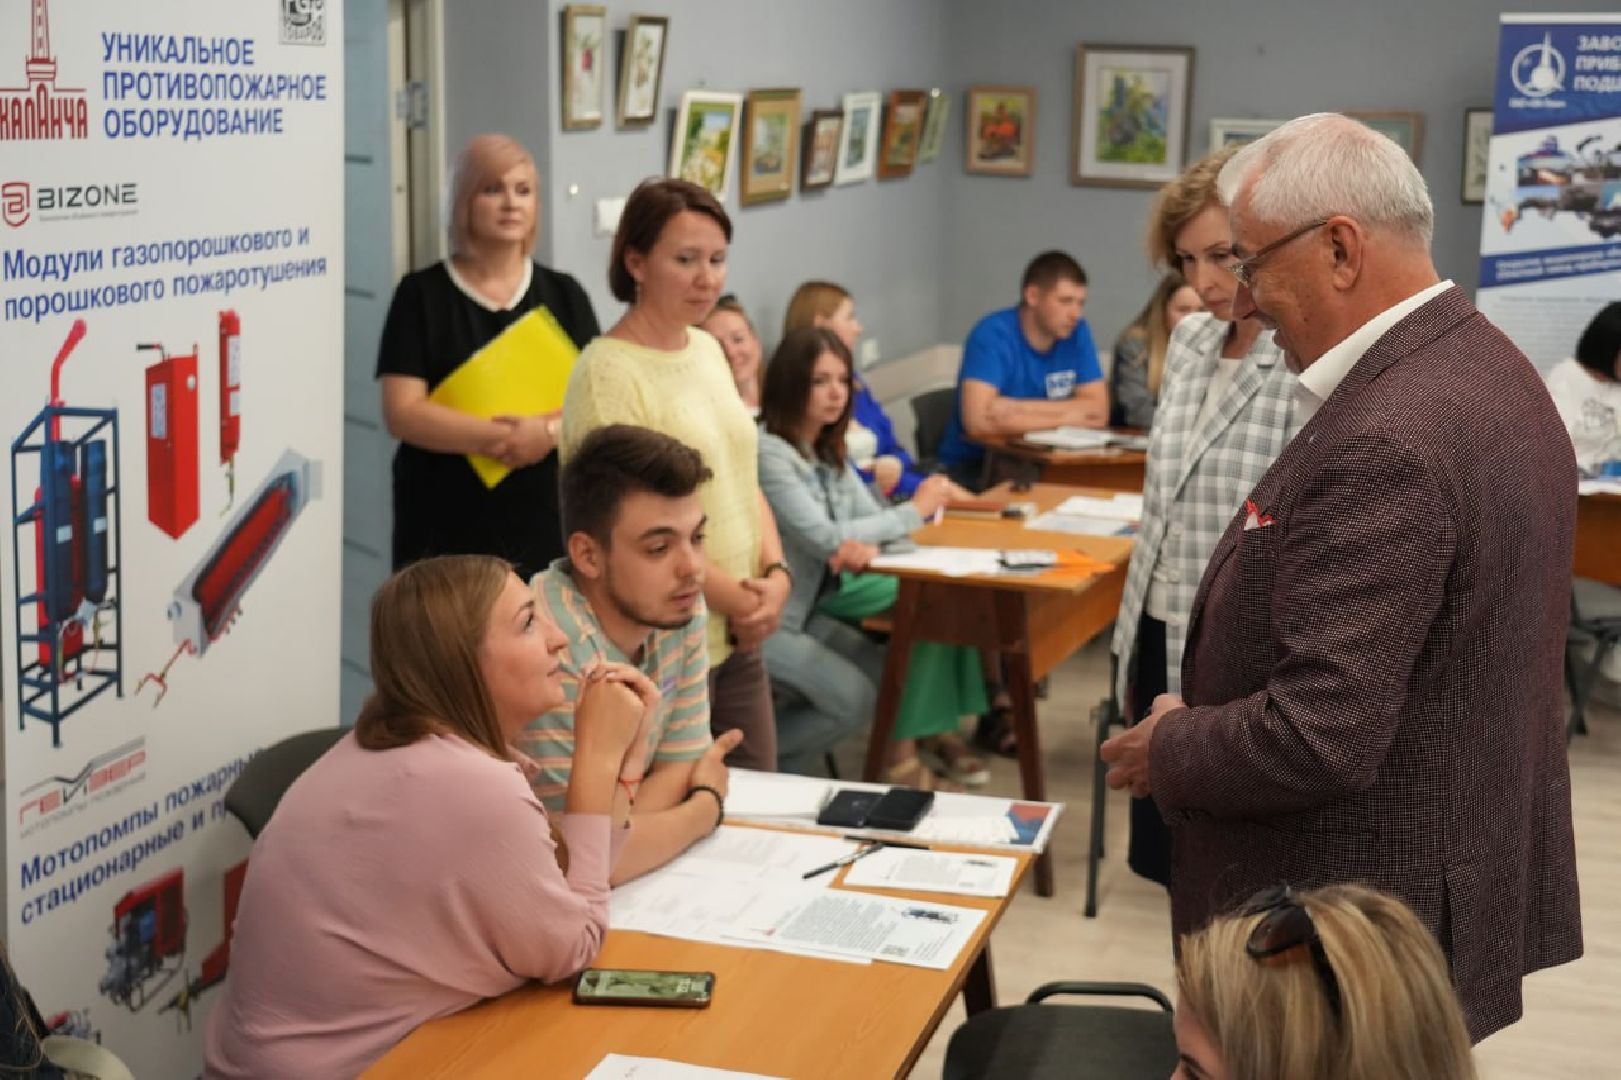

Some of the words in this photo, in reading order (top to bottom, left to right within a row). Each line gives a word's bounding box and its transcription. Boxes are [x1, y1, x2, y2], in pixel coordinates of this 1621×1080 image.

[102, 32, 254, 66] УНИКАЛЬНОЕ
[103, 71, 327, 101] ПРОТИВОПОЖАРНОЕ
[104, 108, 283, 141] ОБОРУДОВАНИЕ
[37, 183, 138, 210] BIZONE
[4, 249, 103, 284] Модули
[112, 230, 292, 269] газопорошкового
[299, 226, 310, 245] и
[5, 280, 165, 323] порошкового
[173, 257, 327, 297] пожаротушения
[20, 802, 158, 890] Мотопомпы
[20, 820, 184, 925] стационарные
[192, 810, 204, 831] и
